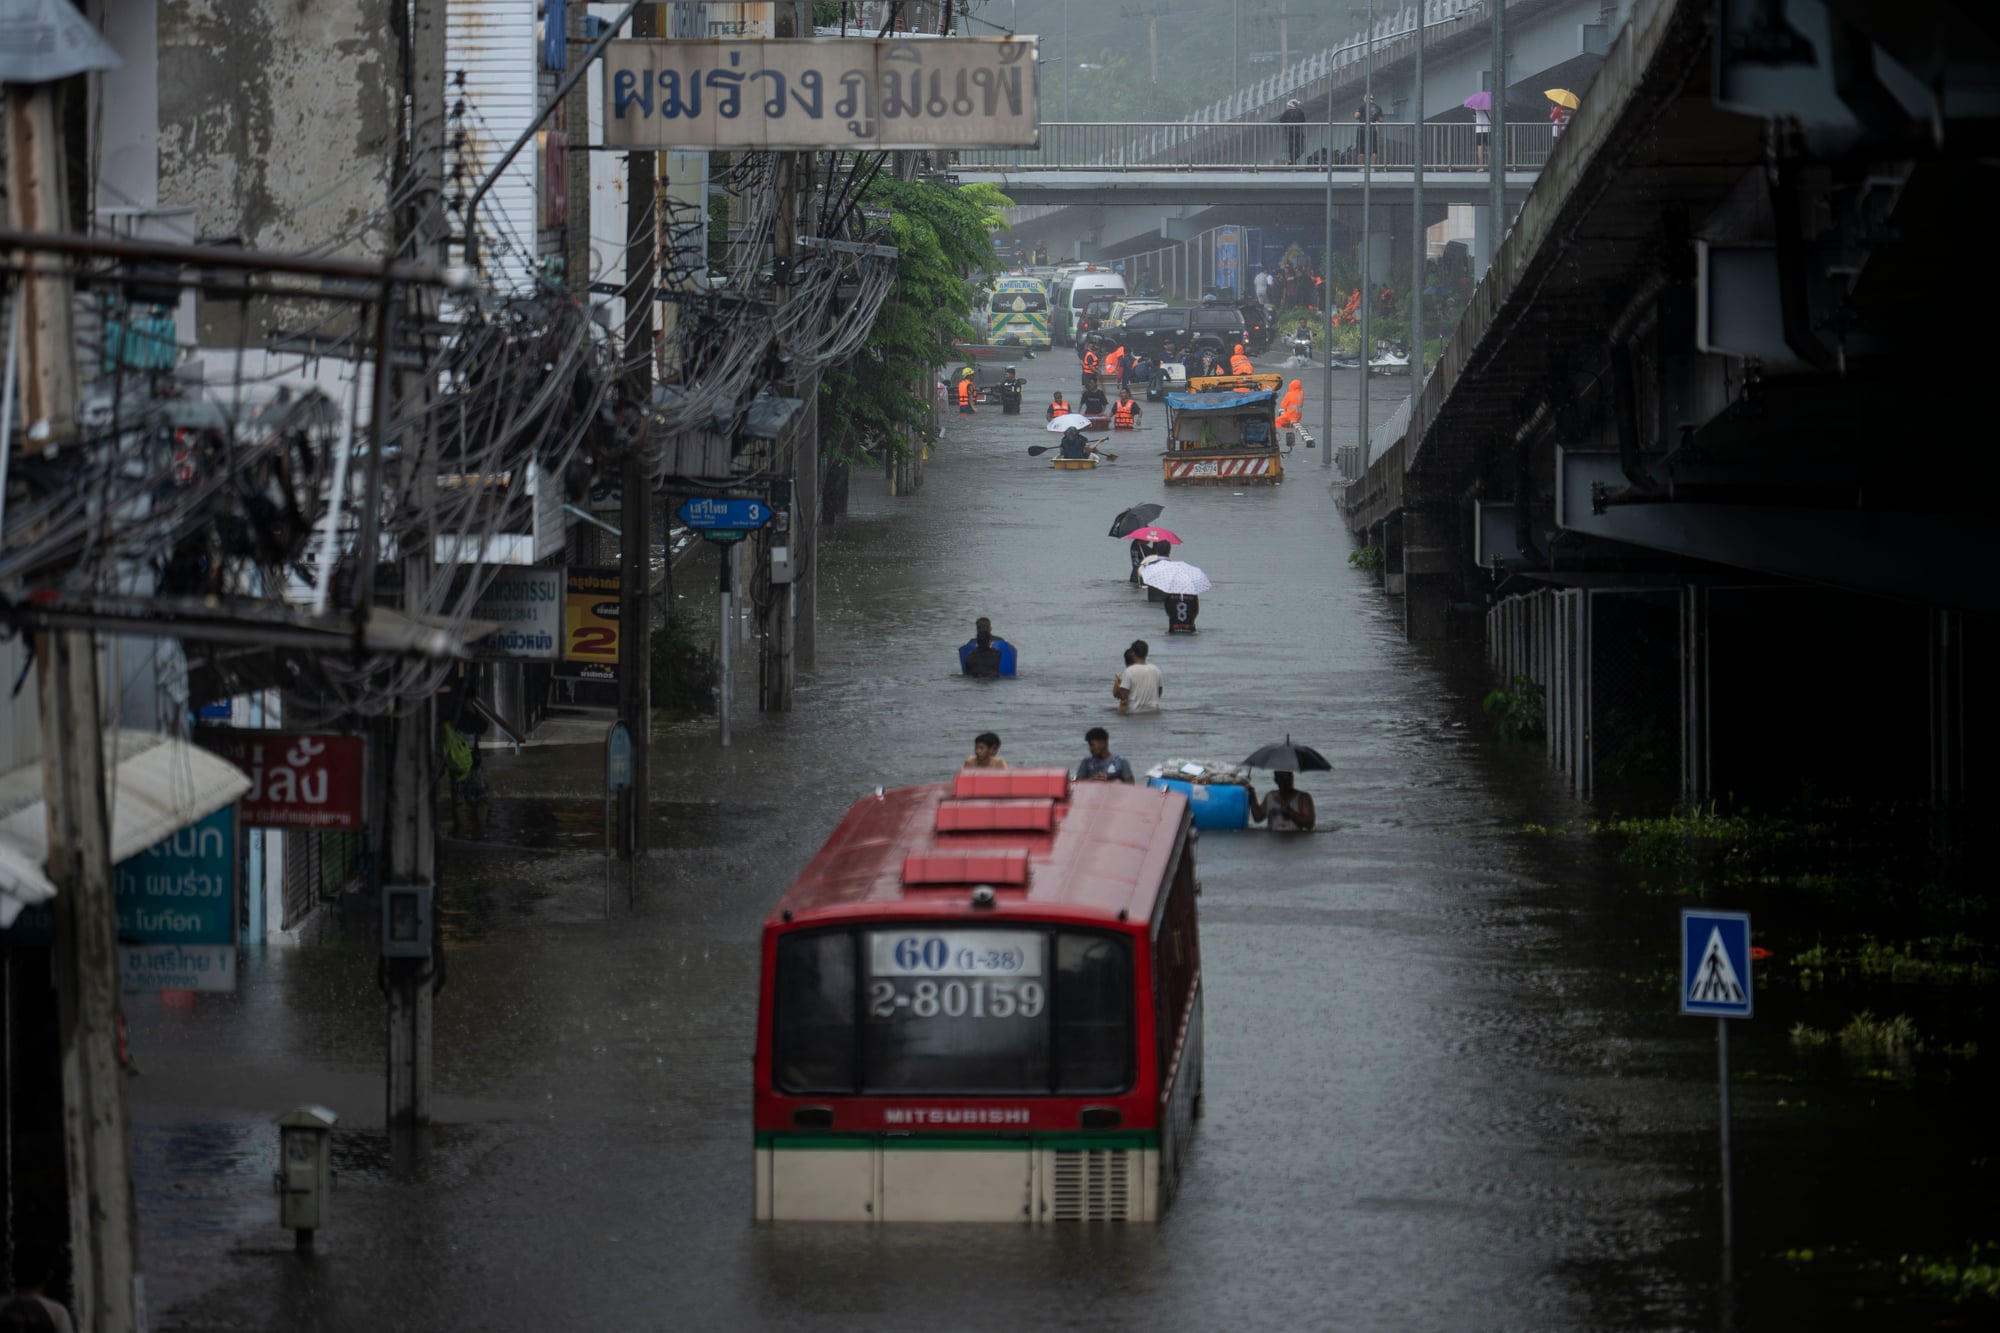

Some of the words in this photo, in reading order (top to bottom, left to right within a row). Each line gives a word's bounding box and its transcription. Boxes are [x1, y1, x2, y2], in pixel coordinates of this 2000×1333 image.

[613, 50, 824, 120] ผมร่วง
[834, 42, 1028, 138] ภูมิแพ้
[999, 282, 1039, 290] AMBULANCE
[690, 498, 728, 515] เสรีไทย
[748, 503, 760, 521] 3
[1176, 602, 1188, 622] 8
[572, 627, 617, 656] 2
[144, 865, 223, 897] ผมร่วง
[136, 906, 202, 932] โบท็อก
[895, 936, 949, 971] 60
[955, 948, 1025, 973] (1-38)
[869, 980, 1044, 1018] 2-80159
[885, 1108, 1030, 1124] MITSUBISHI
